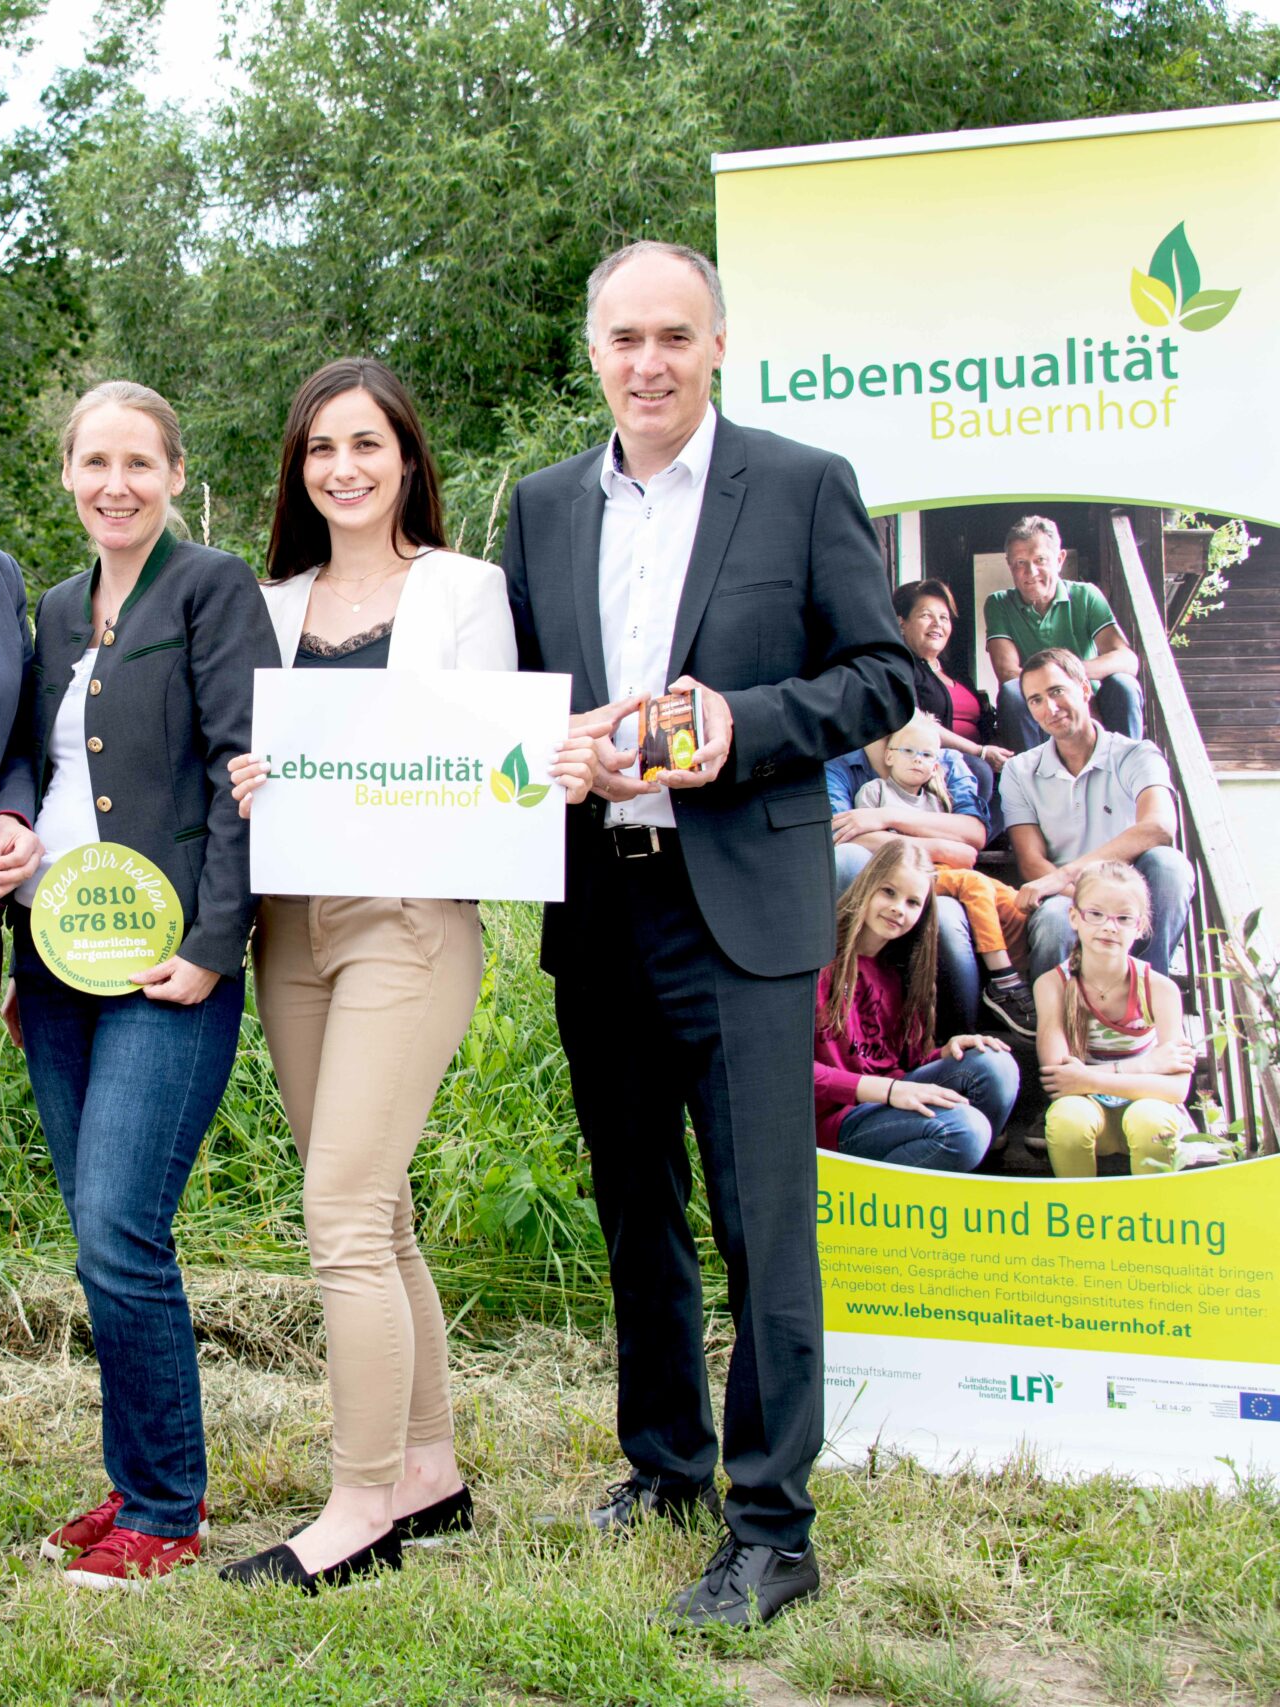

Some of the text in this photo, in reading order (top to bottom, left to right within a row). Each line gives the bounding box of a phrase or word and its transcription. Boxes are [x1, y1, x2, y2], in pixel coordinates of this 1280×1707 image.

[760, 335, 1179, 404] Lebensqualität
[929, 385, 1180, 440] Bauernhof
[266, 753, 483, 786] Lebensqualität
[355, 783, 482, 807] Bauernhof
[40, 848, 167, 915] Lass Dir helfen
[77, 886, 136, 906] 0810
[59, 911, 156, 933] 676 810
[66, 947, 155, 963] Sorgentelefon
[72, 937, 147, 949] Bäuerliches
[816, 1190, 1226, 1256] Bildung und Beratung
[817, 1241, 1274, 1283] Seminare und Vorträge rund um das Thema Lebensqualität bringen
[820, 1259, 1261, 1299] Sichtweisen, Gespräche und Kontakte. Einen Überblick über das
[831, 1277, 886, 1292] Angebot
[891, 1281, 915, 1294] des
[919, 1282, 990, 1300] Ländlichen
[995, 1287, 1144, 1309] Fortbildungsinstitutes
[1149, 1297, 1193, 1313] finden
[1198, 1300, 1220, 1315] Sie
[1225, 1306, 1267, 1318] unter:
[846, 1302, 1192, 1338] www.lebensqualitaet-bauernhof.at
[823, 1362, 922, 1381] wirtschaftskammer
[964, 1375, 1007, 1386] Ländliches
[958, 1382, 1007, 1394] Fortbildungs
[979, 1391, 1007, 1400] Institut
